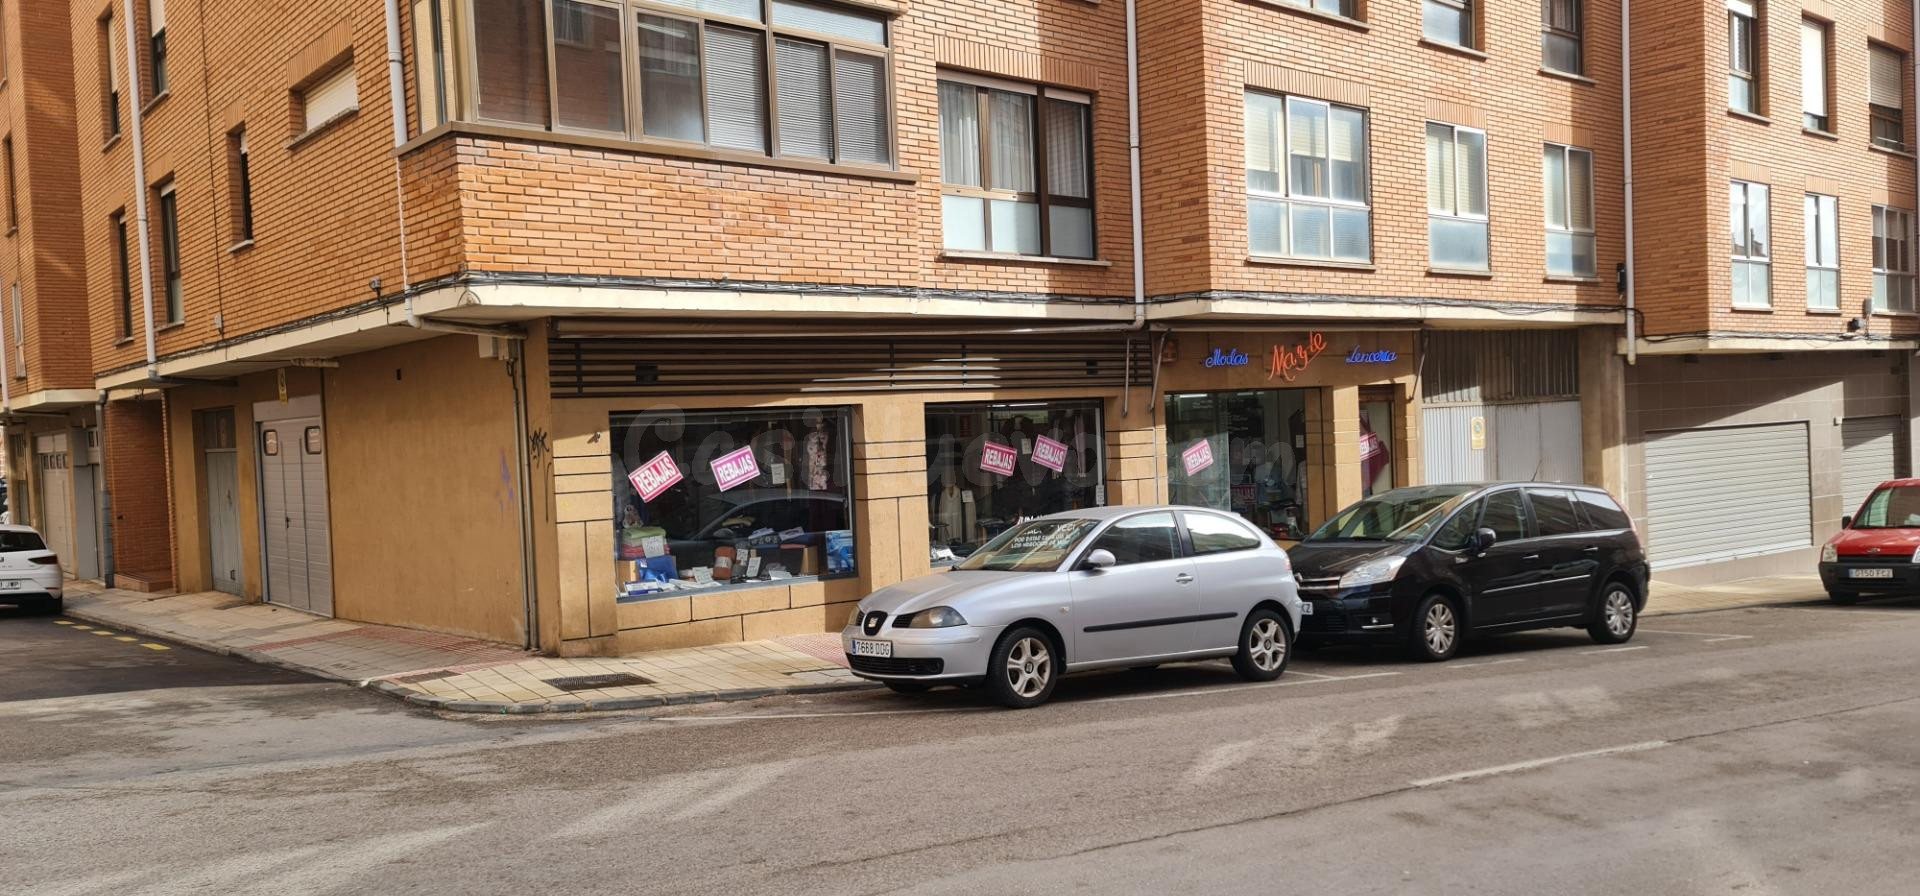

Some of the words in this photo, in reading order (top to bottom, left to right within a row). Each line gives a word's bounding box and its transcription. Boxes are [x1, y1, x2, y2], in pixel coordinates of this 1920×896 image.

[1205, 348, 1248, 367] Modas
[1268, 331, 1327, 381] Mayte
[984, 448, 1013, 470] REBAJAS
[1035, 442, 1064, 466] REBAJAS
[1186, 445, 1212, 468] REBAJAS
[634, 455, 677, 495] REBAJAS
[717, 454, 755, 484] REBAJAS
[856, 641, 873, 654] 7668
